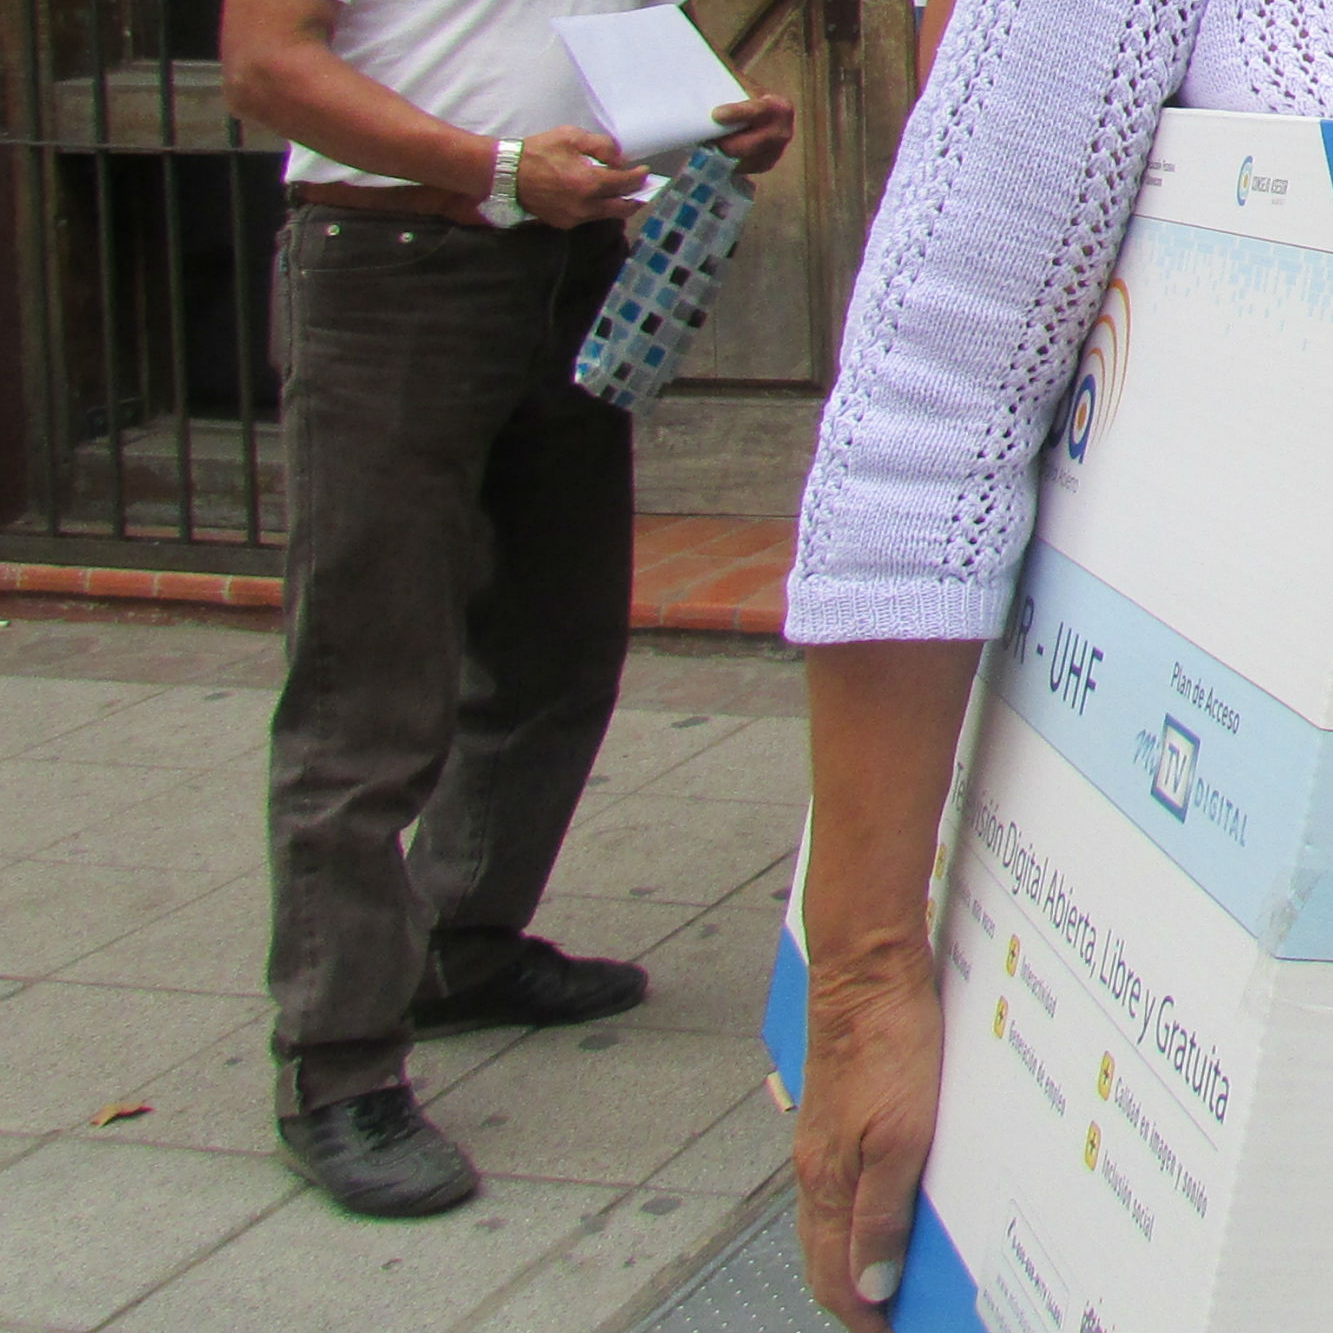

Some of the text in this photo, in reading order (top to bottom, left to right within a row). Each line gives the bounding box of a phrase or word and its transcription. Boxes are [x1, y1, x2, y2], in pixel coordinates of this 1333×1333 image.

[1049, 620, 1104, 716] UHF
[1169, 660, 1241, 736] Plan de Acceso
[1164, 742, 1188, 795] TV
[1192, 776, 1248, 848] DIGITAL
[1002, 820, 1049, 906] Digital
[1043, 869, 1098, 979] Abierta,
[1099, 928, 1142, 1019] Libre
[1136, 988, 1157, 1046] y
[1155, 994, 1231, 1125] Gratuita
